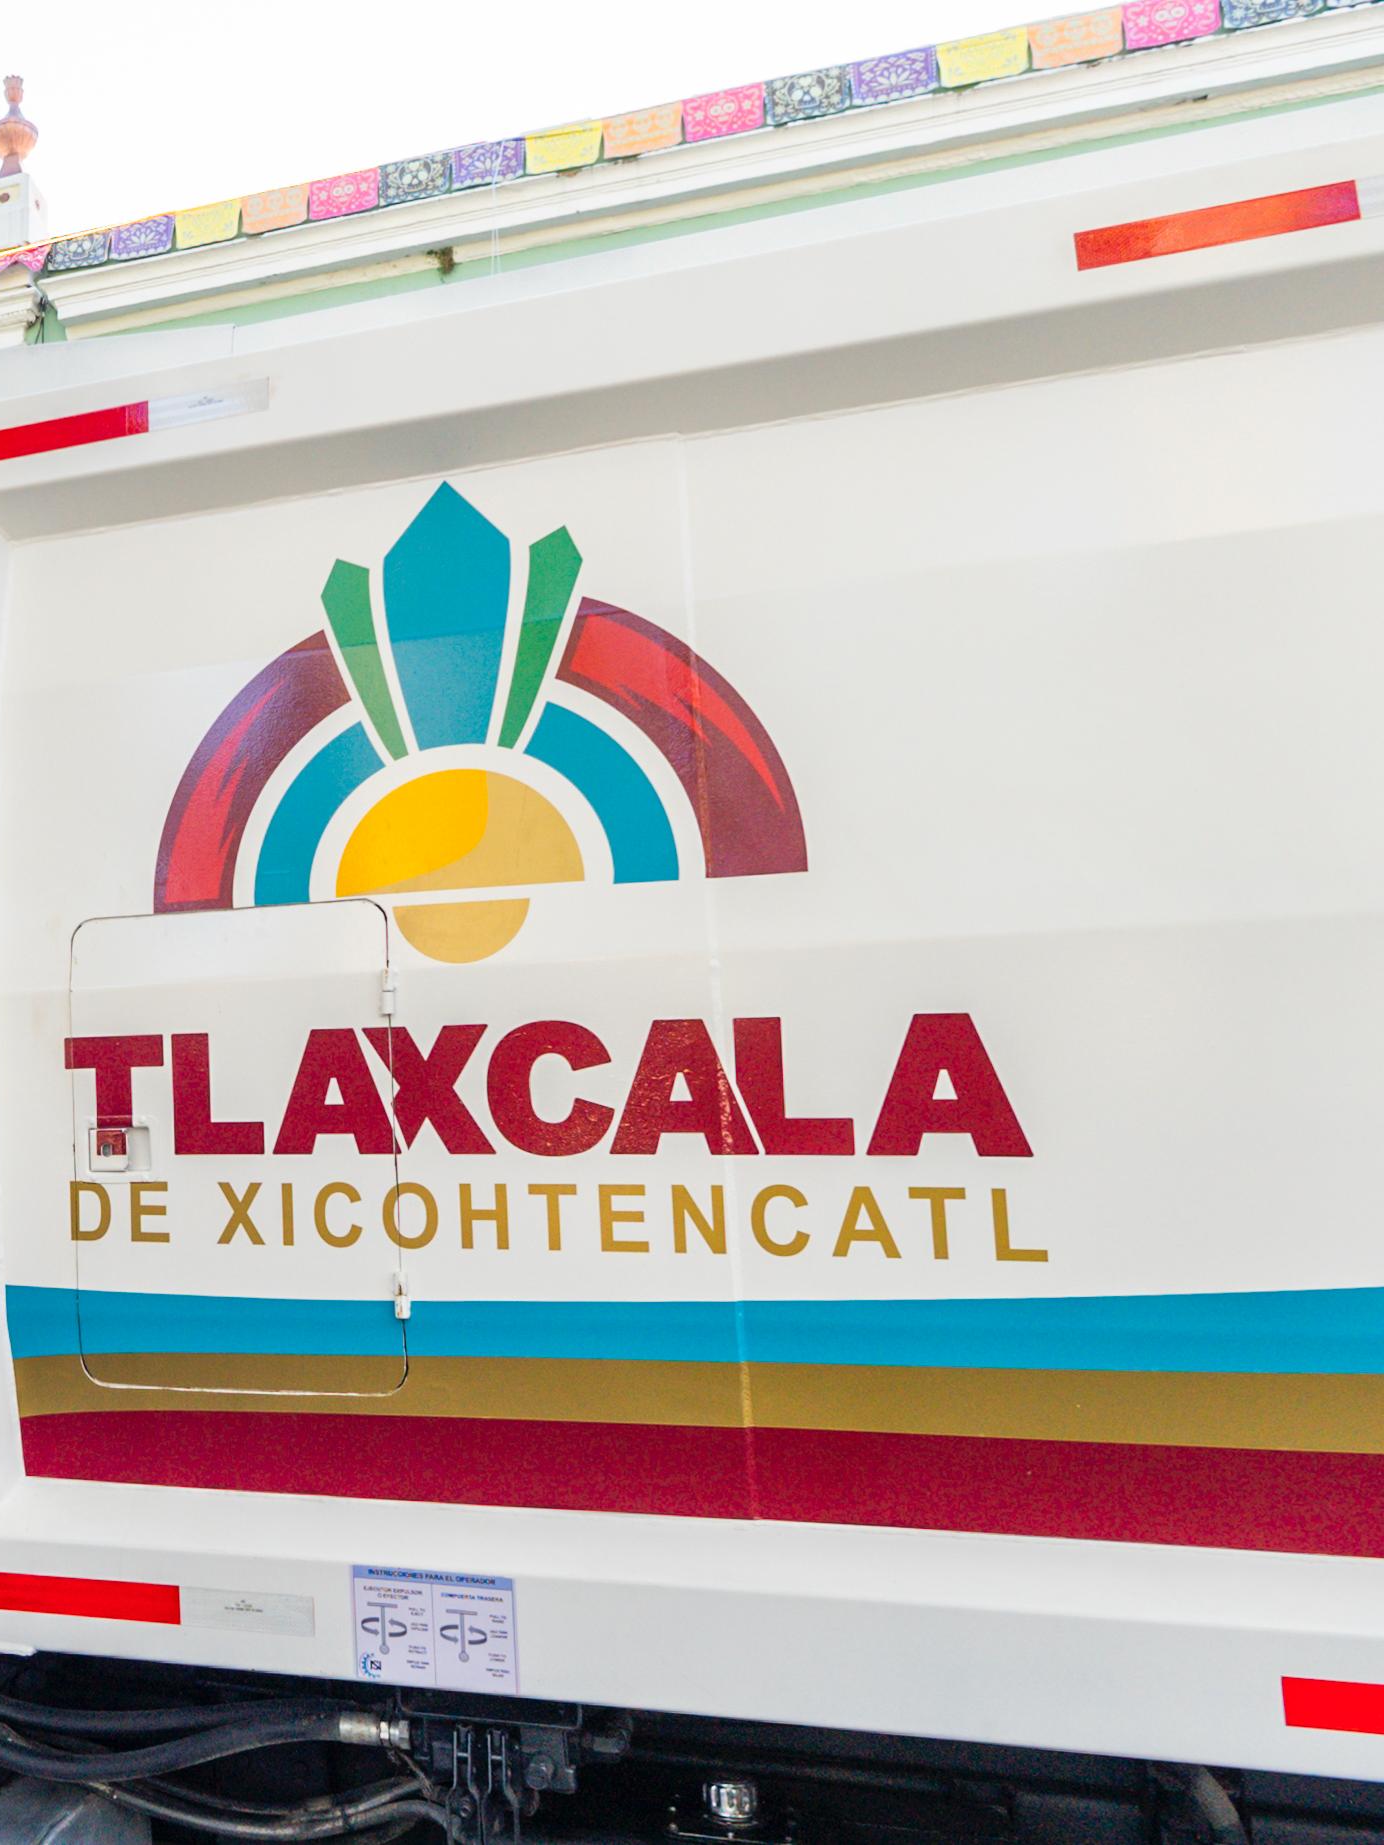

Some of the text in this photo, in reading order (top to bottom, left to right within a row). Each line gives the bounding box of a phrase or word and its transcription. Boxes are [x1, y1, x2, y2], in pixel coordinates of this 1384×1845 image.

[64, 1013, 1034, 1158] TLAXCALA
[69, 1181, 1049, 1263] DE XICOHTENCATL
[425, 1573, 444, 1582] PARA
[456, 1576, 496, 1585] OPERADOR
